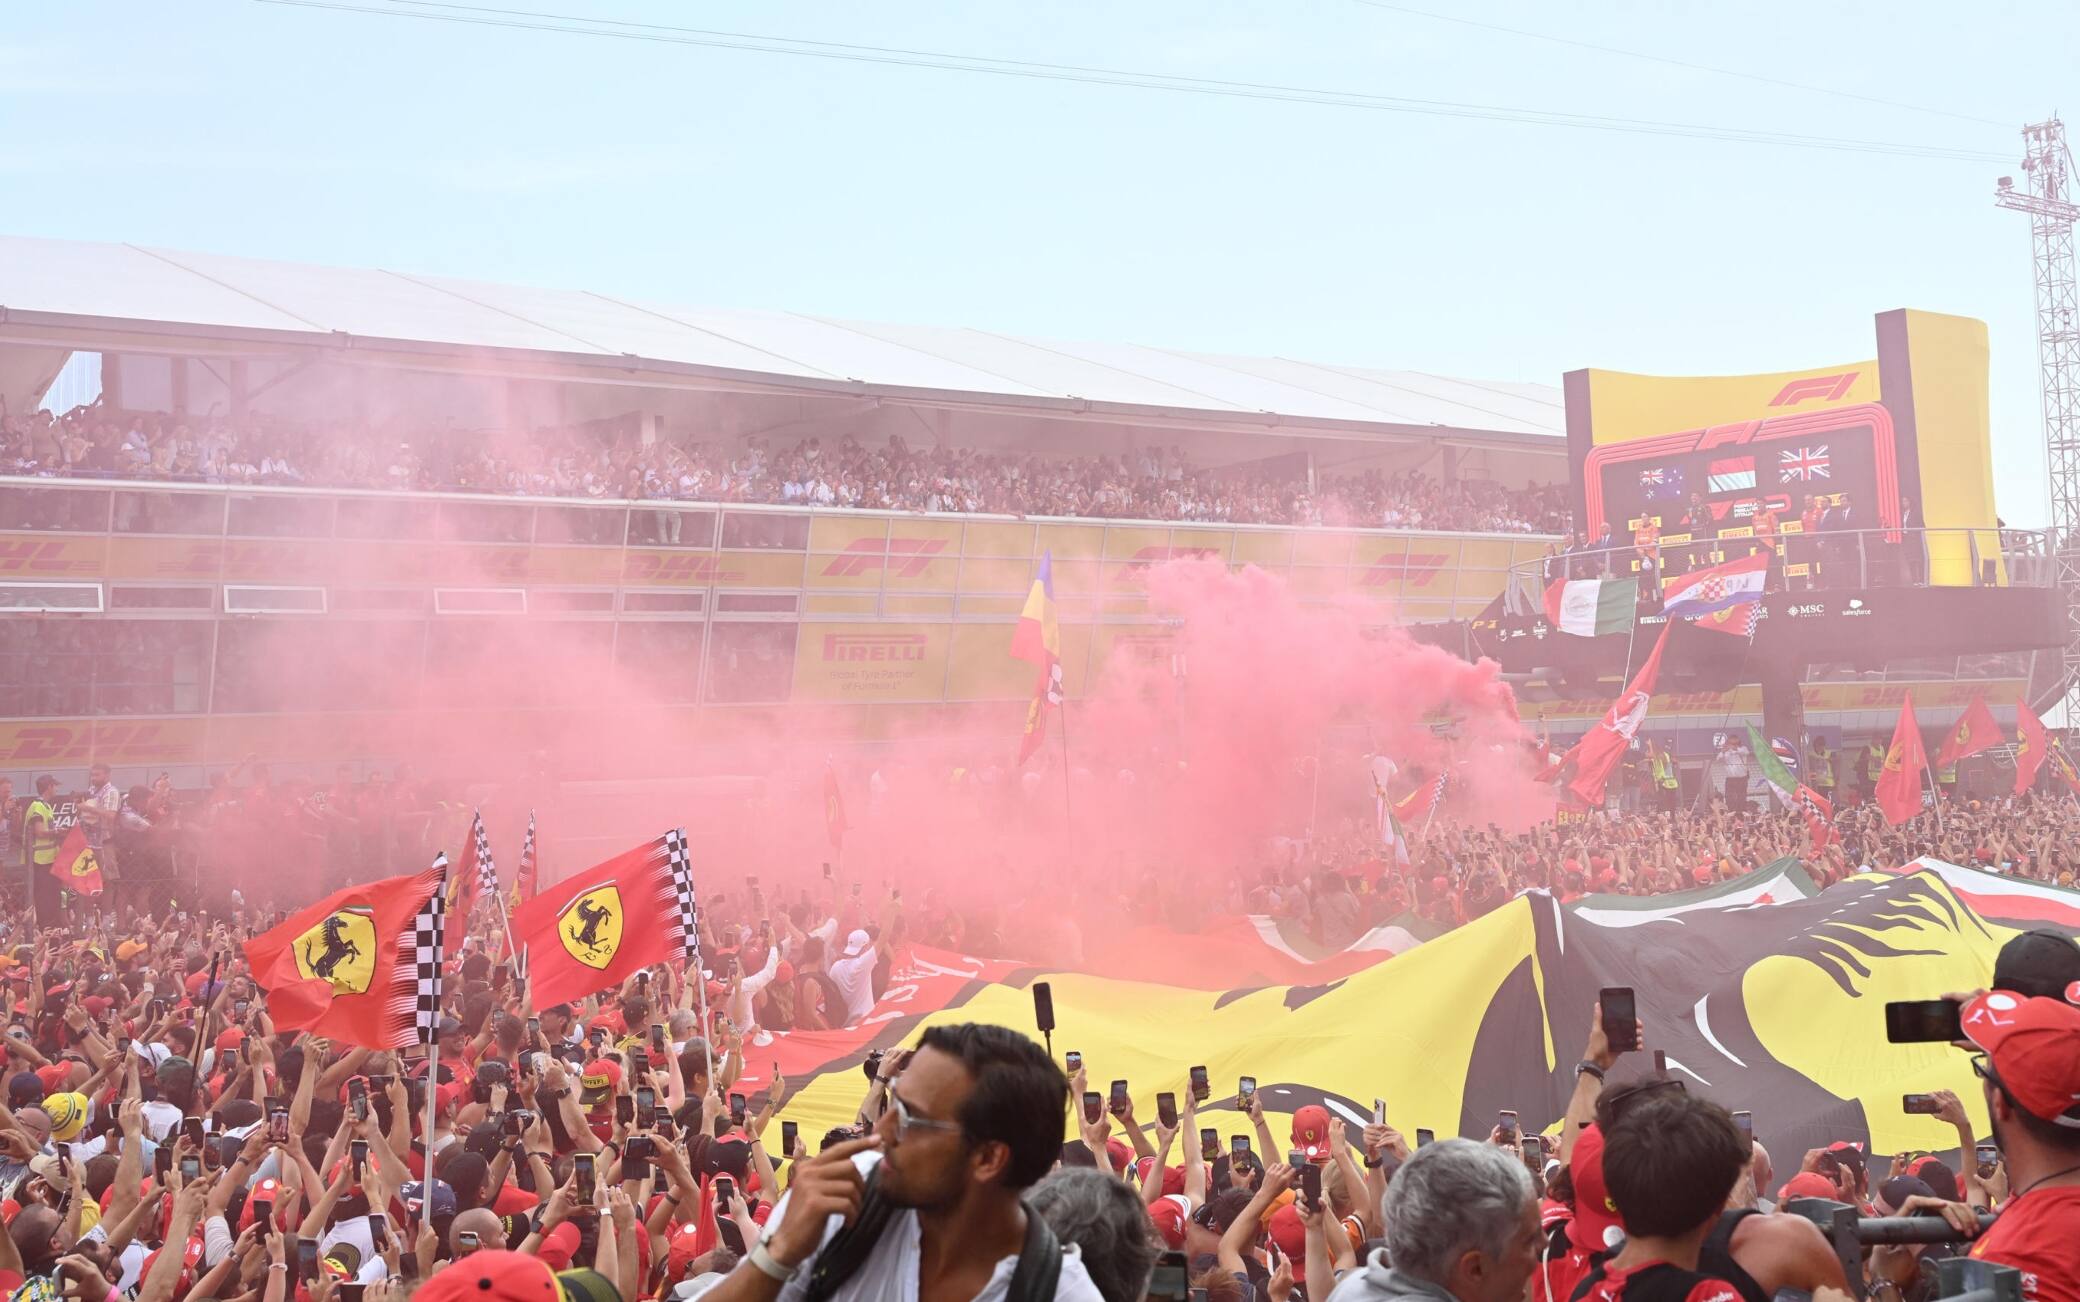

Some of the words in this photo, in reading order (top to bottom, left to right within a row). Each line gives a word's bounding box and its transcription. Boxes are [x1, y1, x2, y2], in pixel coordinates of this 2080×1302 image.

[1768, 372, 1860, 406] F1
[0, 541, 70, 570] HL
[622, 555, 722, 580] DHL
[820, 538, 949, 577] F1
[1361, 553, 1449, 587] F1
[1800, 604, 1825, 614] MSC
[823, 633, 928, 661] PIRELLI
[831, 671, 856, 680] Global
[861, 670, 879, 681] Tyre
[881, 670, 914, 680] Partner
[12, 727, 163, 758] DHL
